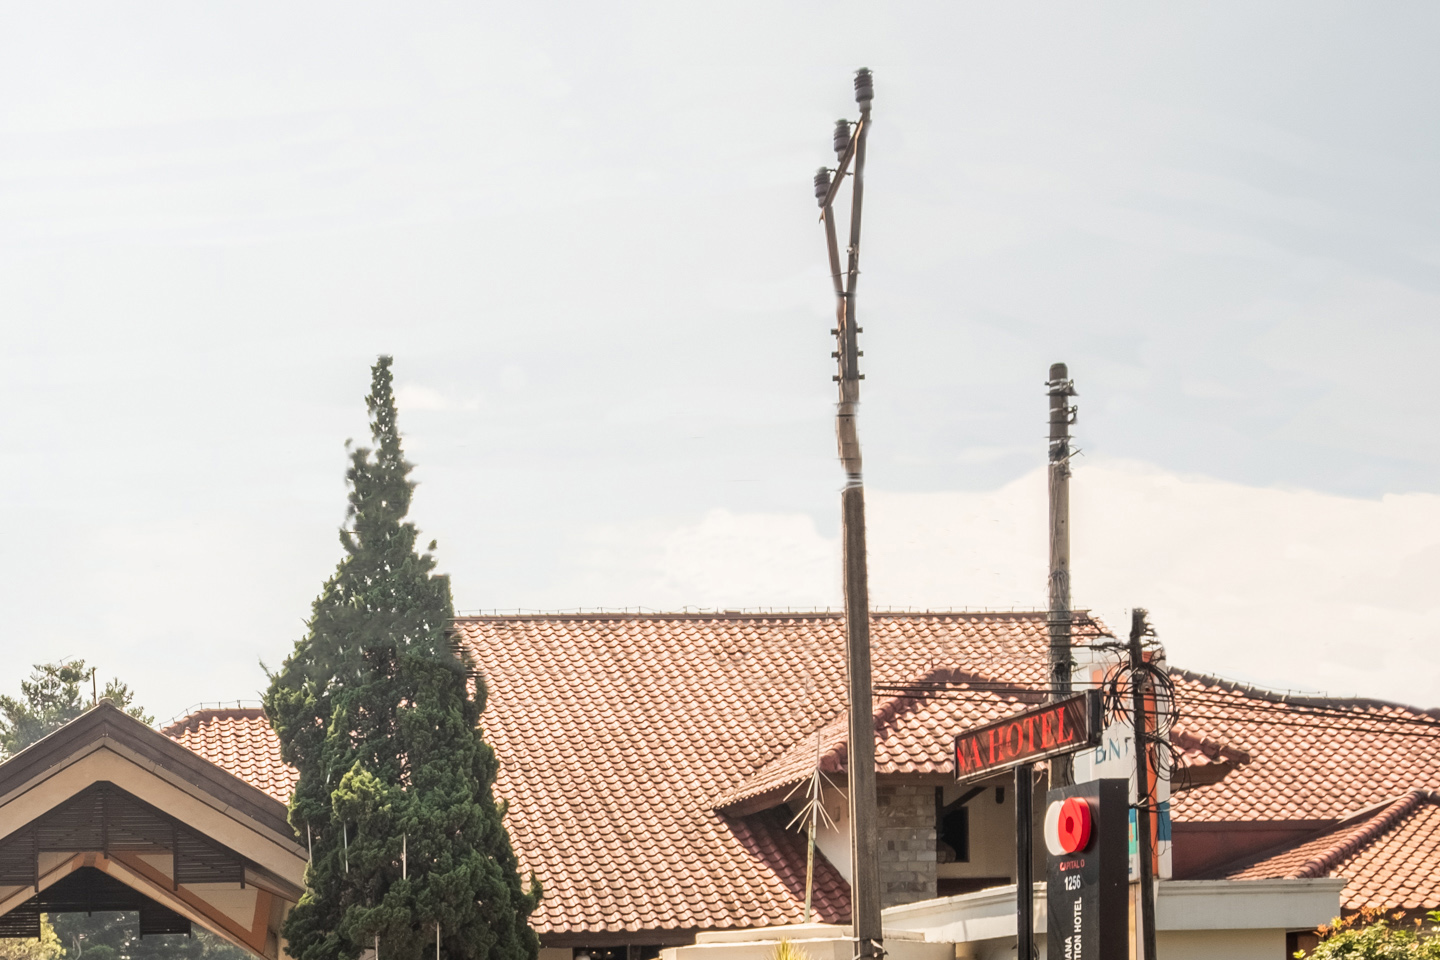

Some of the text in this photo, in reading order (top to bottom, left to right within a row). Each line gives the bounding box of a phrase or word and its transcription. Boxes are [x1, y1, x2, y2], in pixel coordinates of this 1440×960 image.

[988, 706, 1073, 764] HOTEL
[1059, 860, 1080, 871] CAPITAL
[1064, 874, 1081, 891] 1256
[1074, 897, 1082, 933] HOTEL
